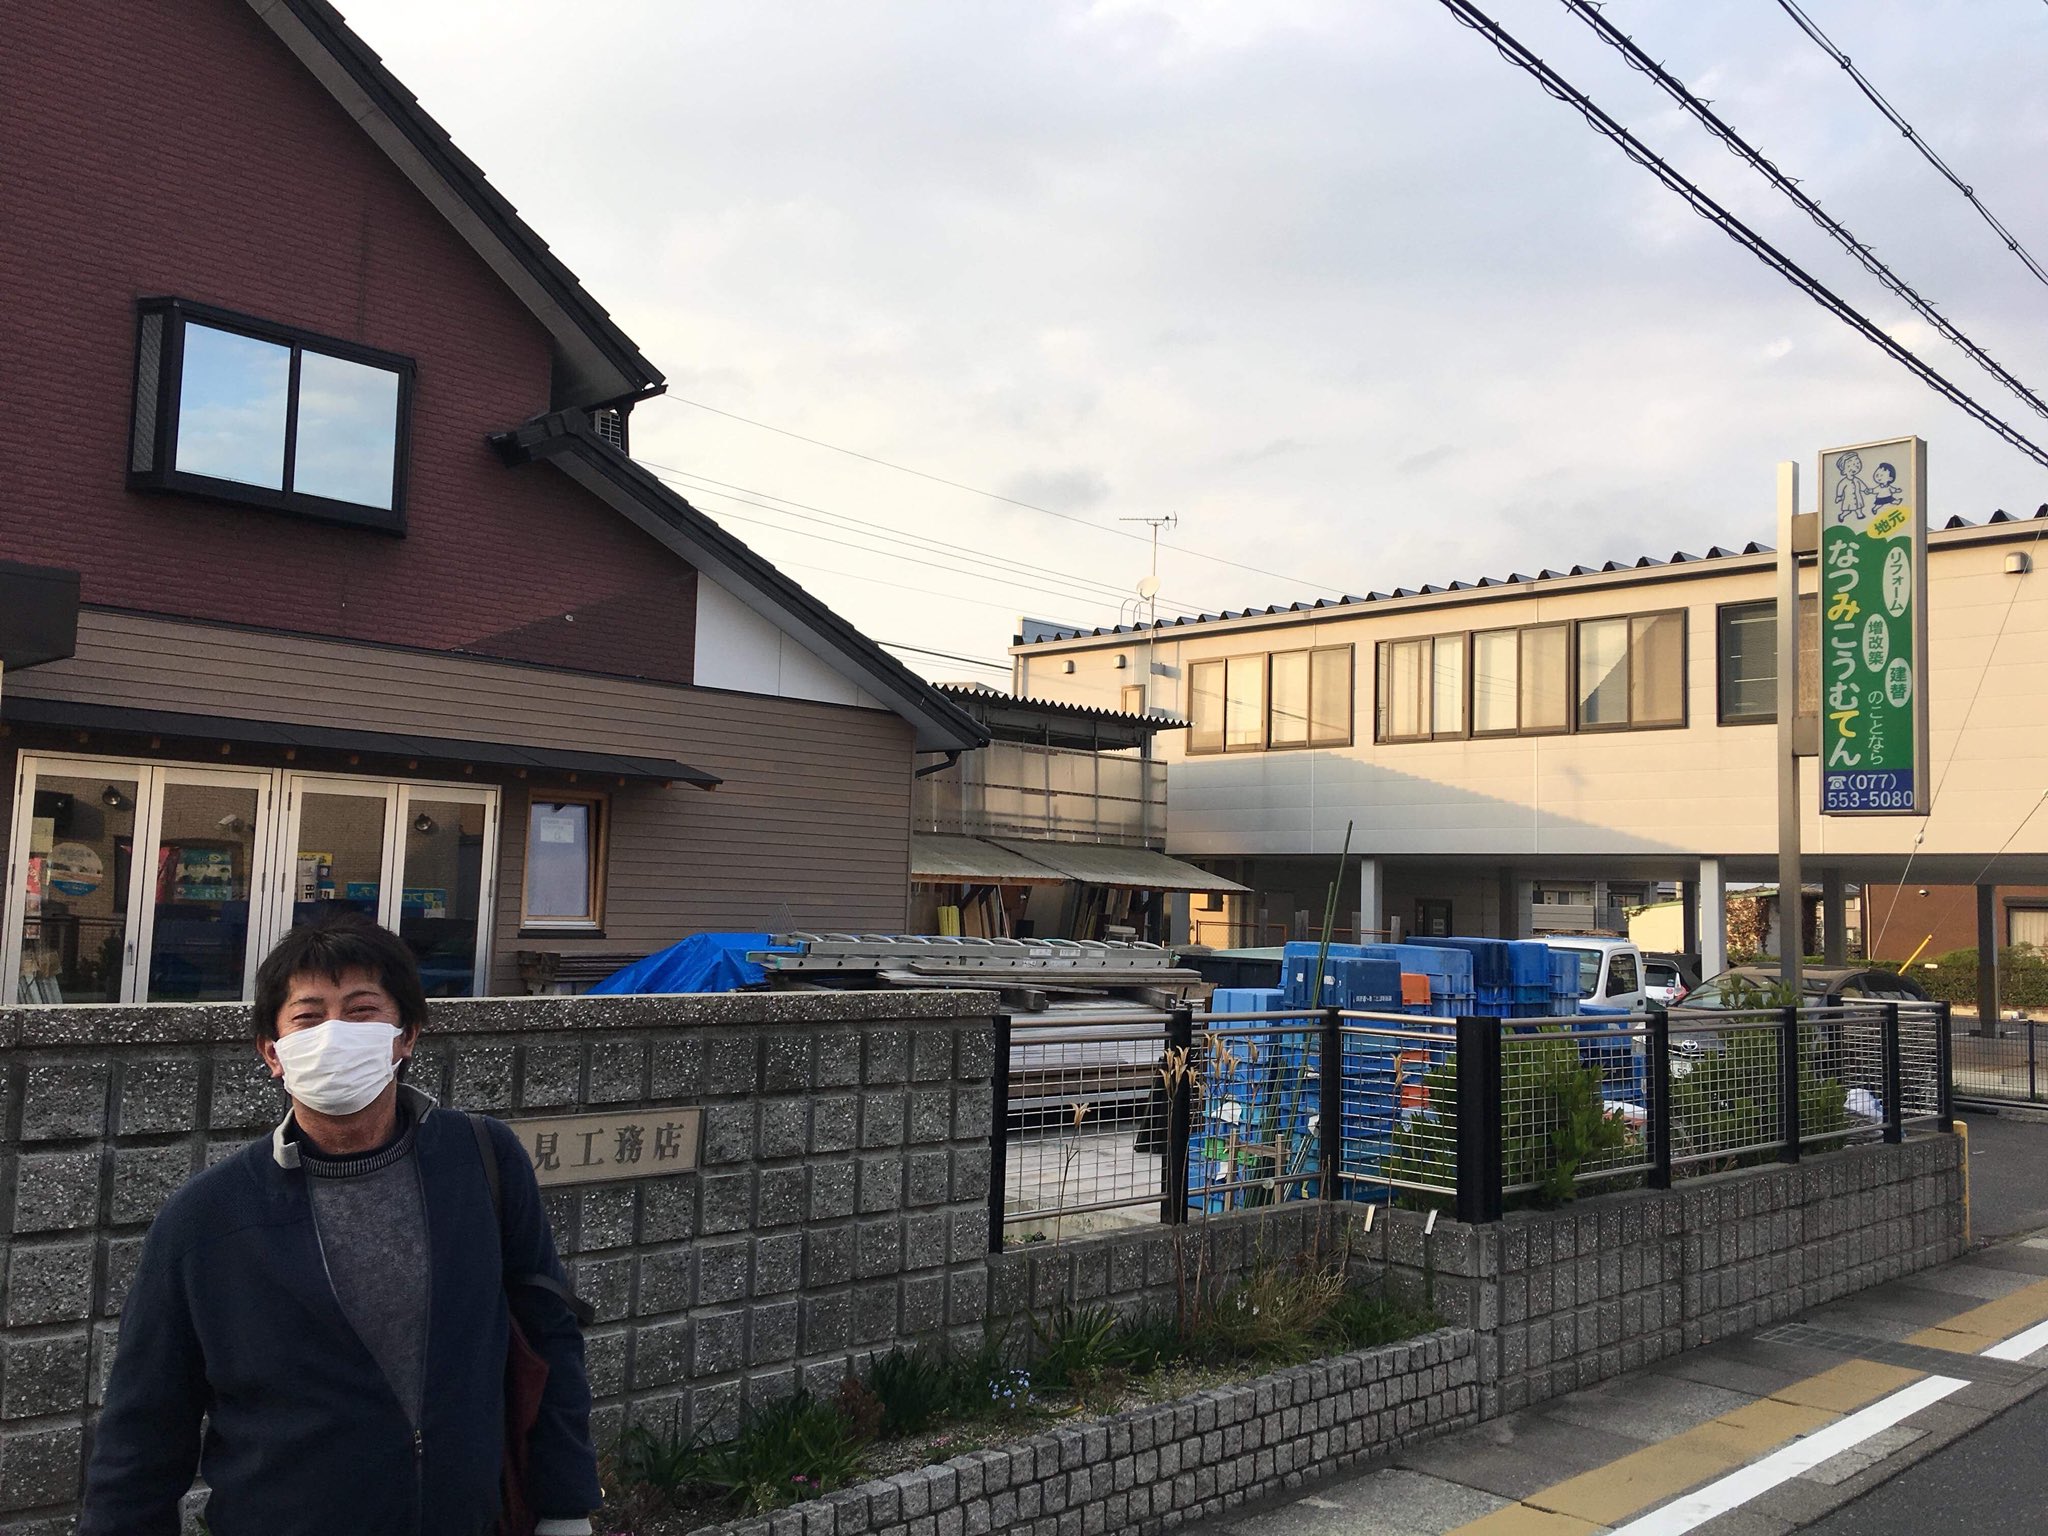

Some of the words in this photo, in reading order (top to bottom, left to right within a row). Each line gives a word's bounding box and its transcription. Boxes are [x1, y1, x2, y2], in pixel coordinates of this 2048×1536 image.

[1874, 509, 1906, 536] 地元
[1890, 552, 1904, 611] リフォーム
[1828, 539, 1861, 767] なつみこうむてん
[1868, 620, 1884, 666] 増改築
[1890, 666, 1907, 700] 建替
[1868, 690, 1884, 765] のことなら
[1827, 790, 1913, 807] 553-5080
[1848, 773, 1897, 790] (077)
